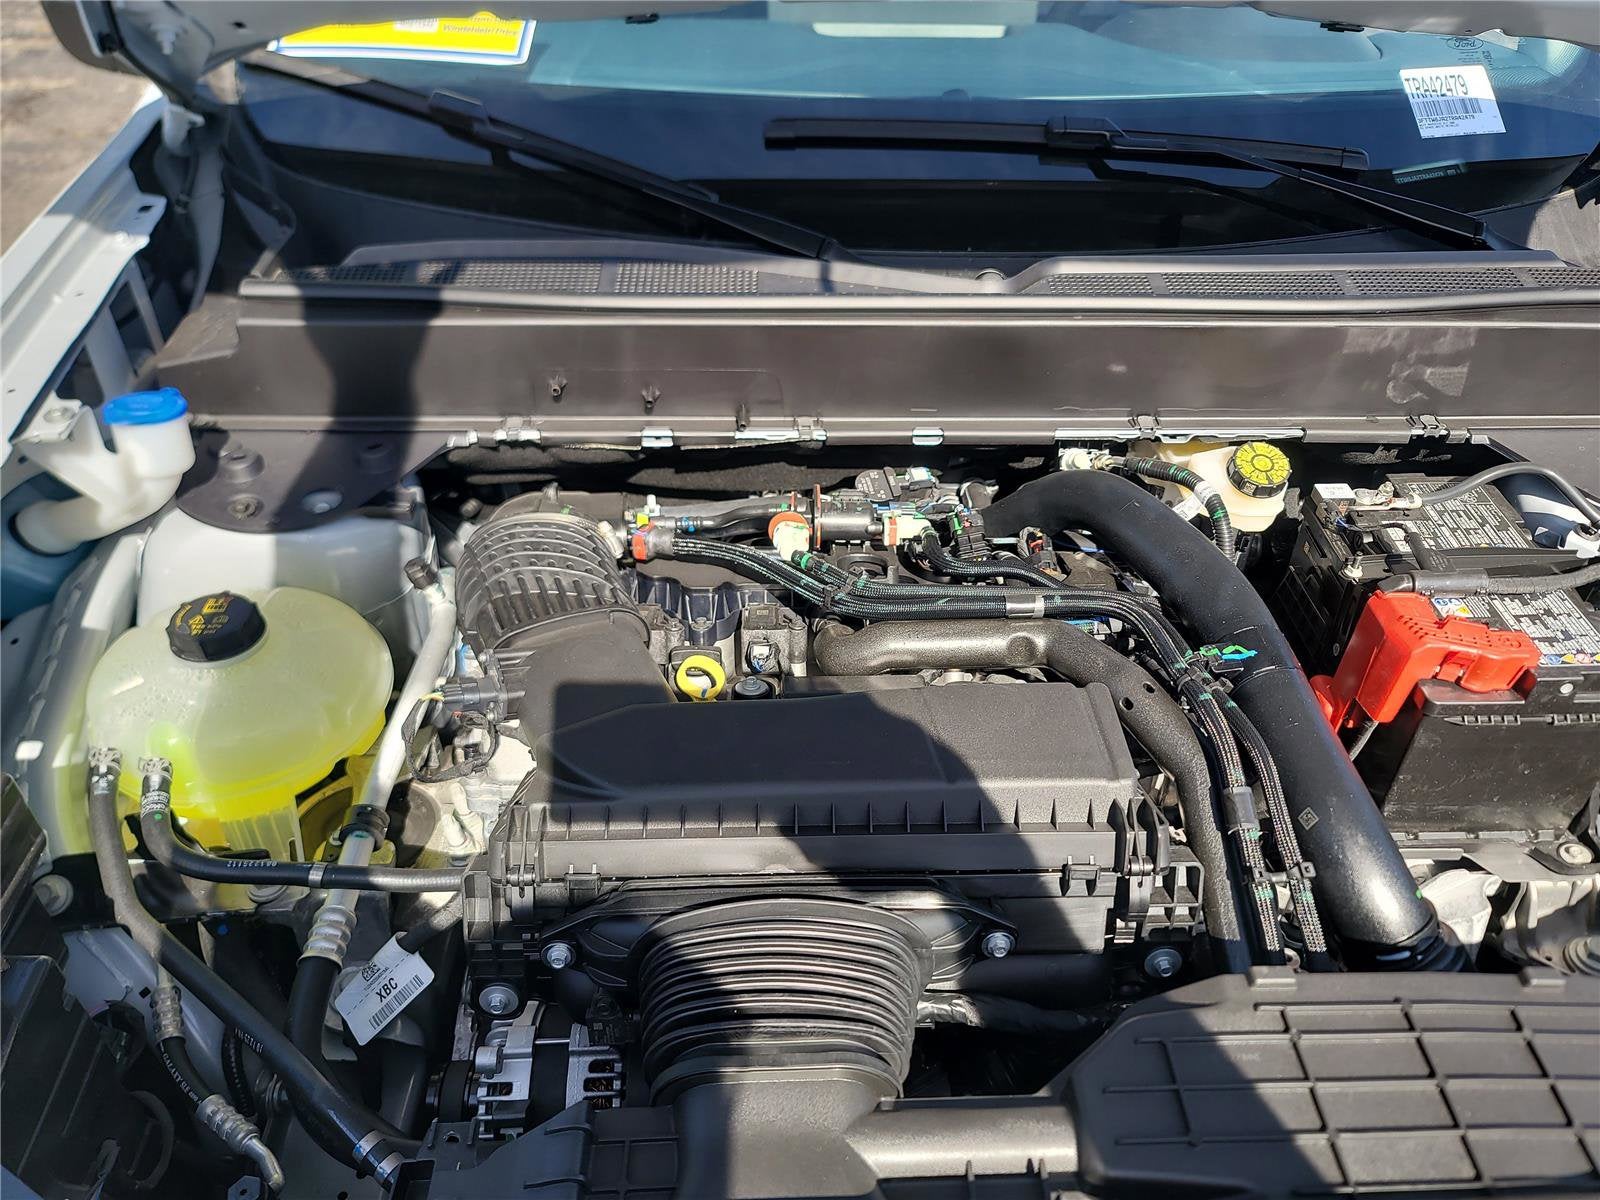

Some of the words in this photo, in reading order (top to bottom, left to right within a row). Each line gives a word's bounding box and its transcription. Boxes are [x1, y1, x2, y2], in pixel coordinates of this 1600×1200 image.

[1452, 38, 1477, 48] Ford
[1404, 74, 1469, 99] TRA42479
[375, 977, 398, 1003] XBC
